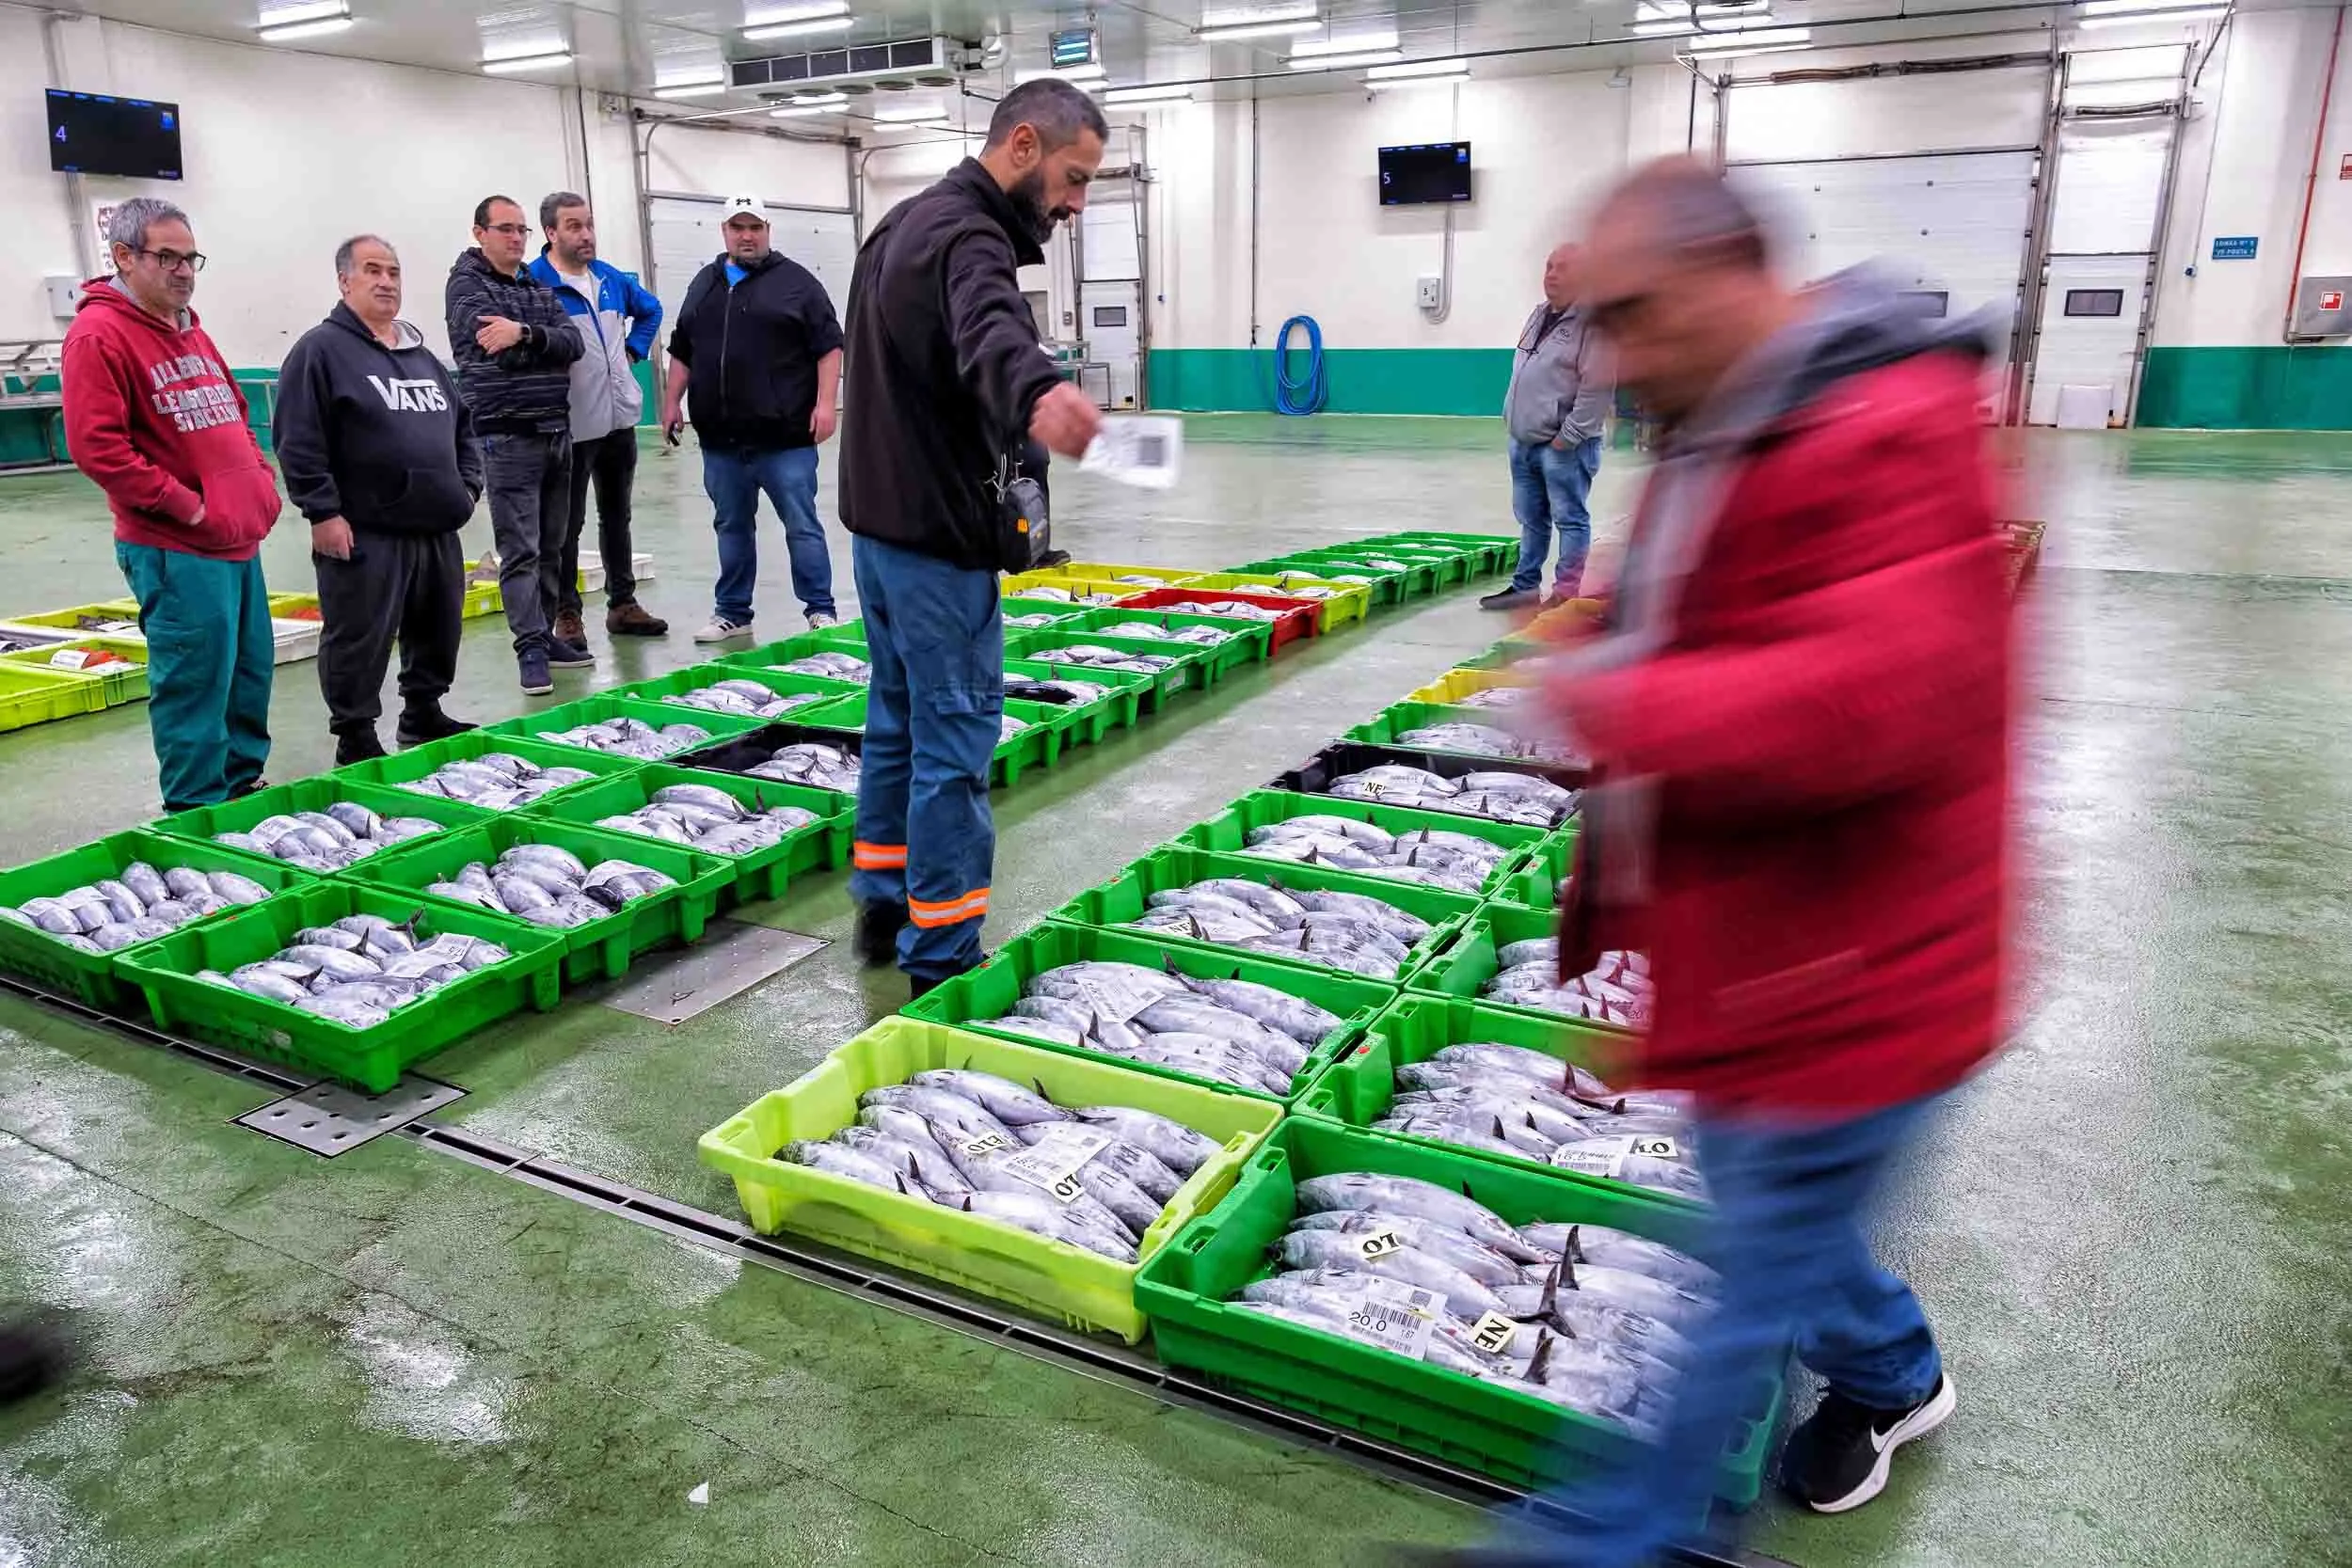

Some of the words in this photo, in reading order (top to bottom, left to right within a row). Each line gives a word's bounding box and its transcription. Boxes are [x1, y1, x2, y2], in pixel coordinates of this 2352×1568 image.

[55, 125, 67, 142] 4
[1383, 172, 1391, 184] 5
[366, 374, 448, 412] VANS
[1348, 1311, 1387, 1332] 20,0
[1474, 1318, 1511, 1350] NE
